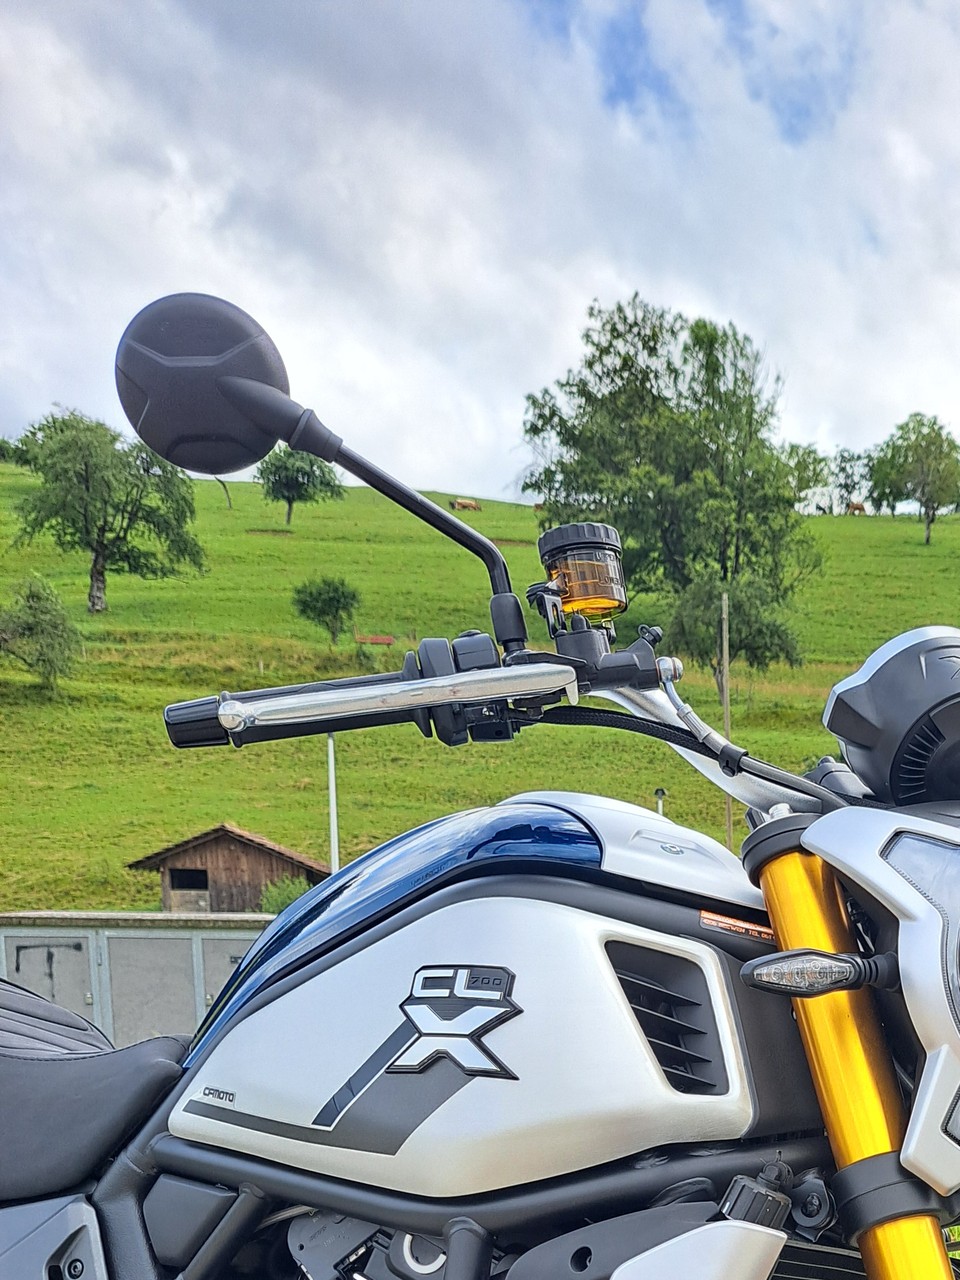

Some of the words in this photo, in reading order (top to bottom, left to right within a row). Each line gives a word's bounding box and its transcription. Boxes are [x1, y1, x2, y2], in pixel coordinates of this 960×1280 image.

[411, 968, 504, 1002] CL
[470, 976, 503, 987] 700
[202, 1086, 235, 1103] CFMOTO
